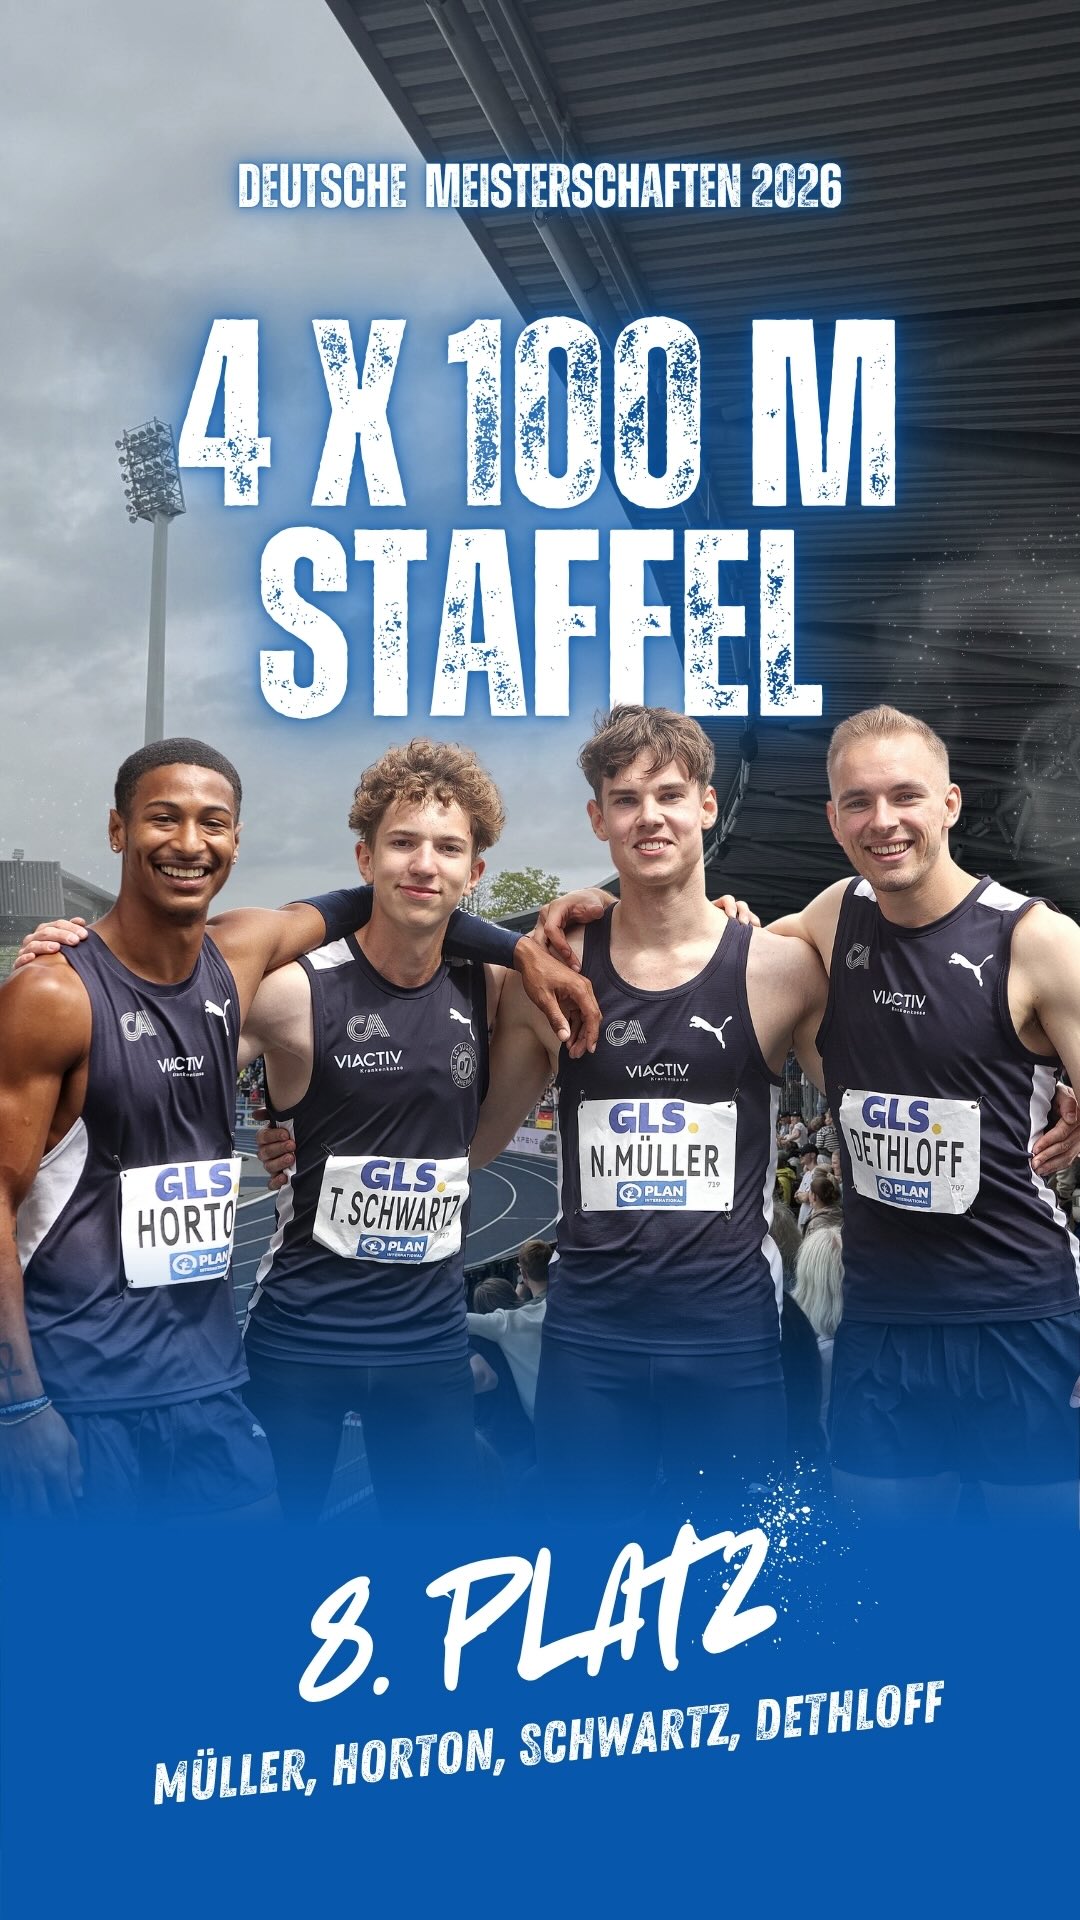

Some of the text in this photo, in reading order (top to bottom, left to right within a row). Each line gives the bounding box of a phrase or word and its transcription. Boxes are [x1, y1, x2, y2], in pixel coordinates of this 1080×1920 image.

[872, 990, 927, 1009] VIACTIV
[156, 1055, 205, 1074] VIACTIV
[333, 1050, 403, 1069] VIACTIV
[625, 1062, 690, 1078] VIACTIV
[590, 1135, 720, 1178] N.MÜLLER
[849, 1127, 965, 1178] DETHLOFF
[644, 1185, 684, 1197] PLAN
[893, 1183, 929, 1199] PLAN
[329, 1186, 461, 1231] T.SCHWARTZ
[388, 1240, 425, 1253] PLAN
